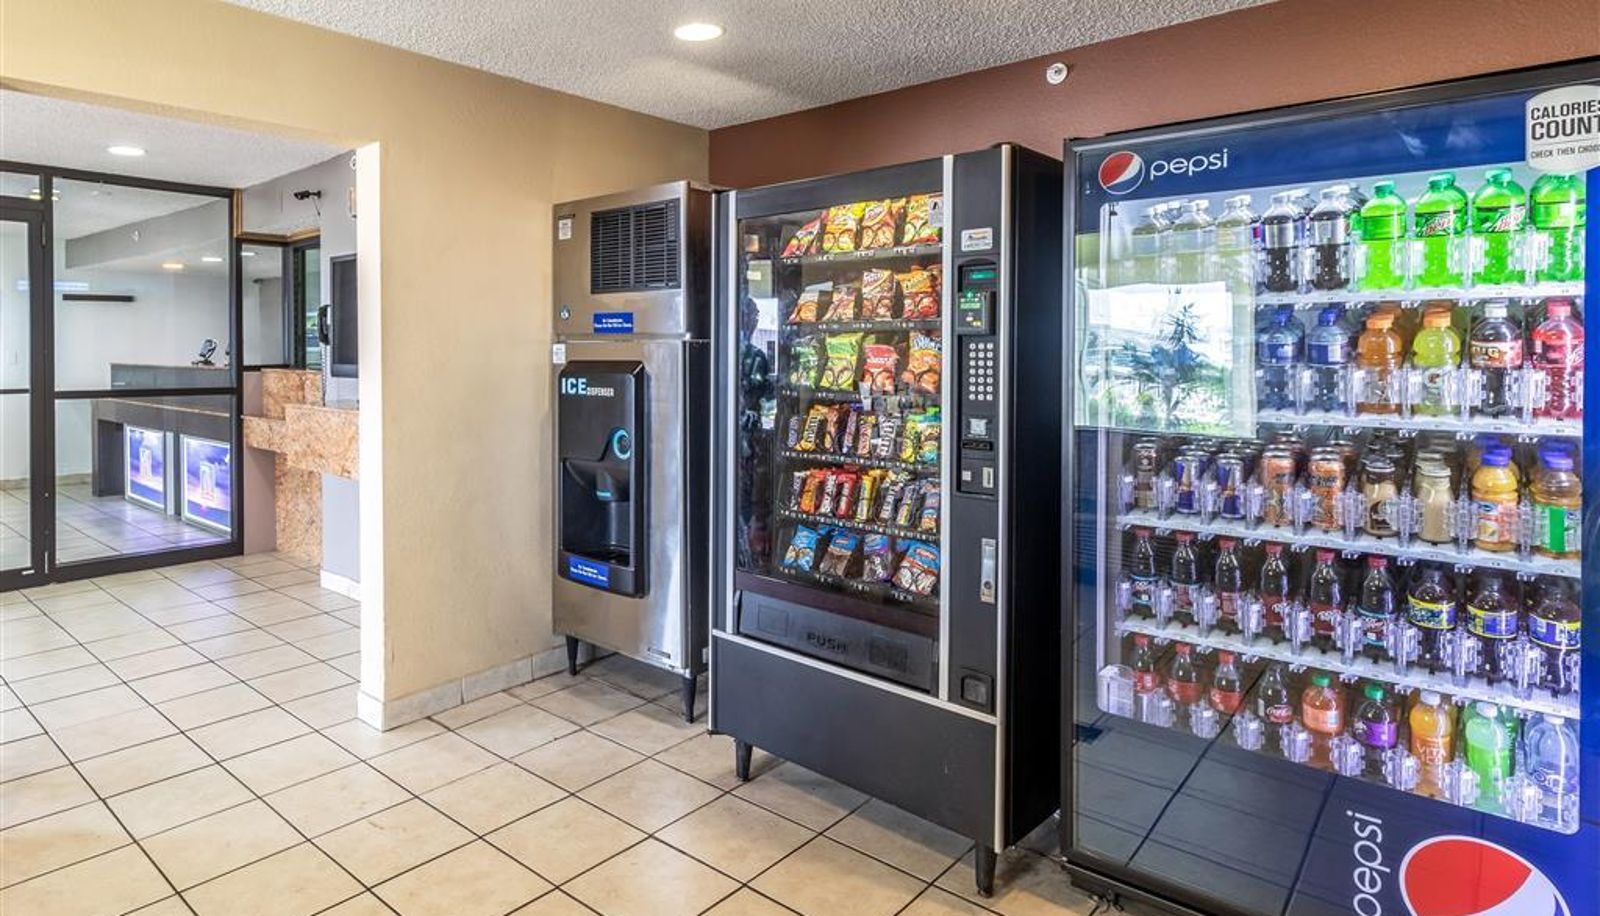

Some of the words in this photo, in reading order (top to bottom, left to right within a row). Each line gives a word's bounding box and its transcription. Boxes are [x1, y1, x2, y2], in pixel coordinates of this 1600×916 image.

[1150, 148, 1228, 181] pepsi
[561, 377, 587, 395] ICE
[806, 631, 848, 653] PUSH
